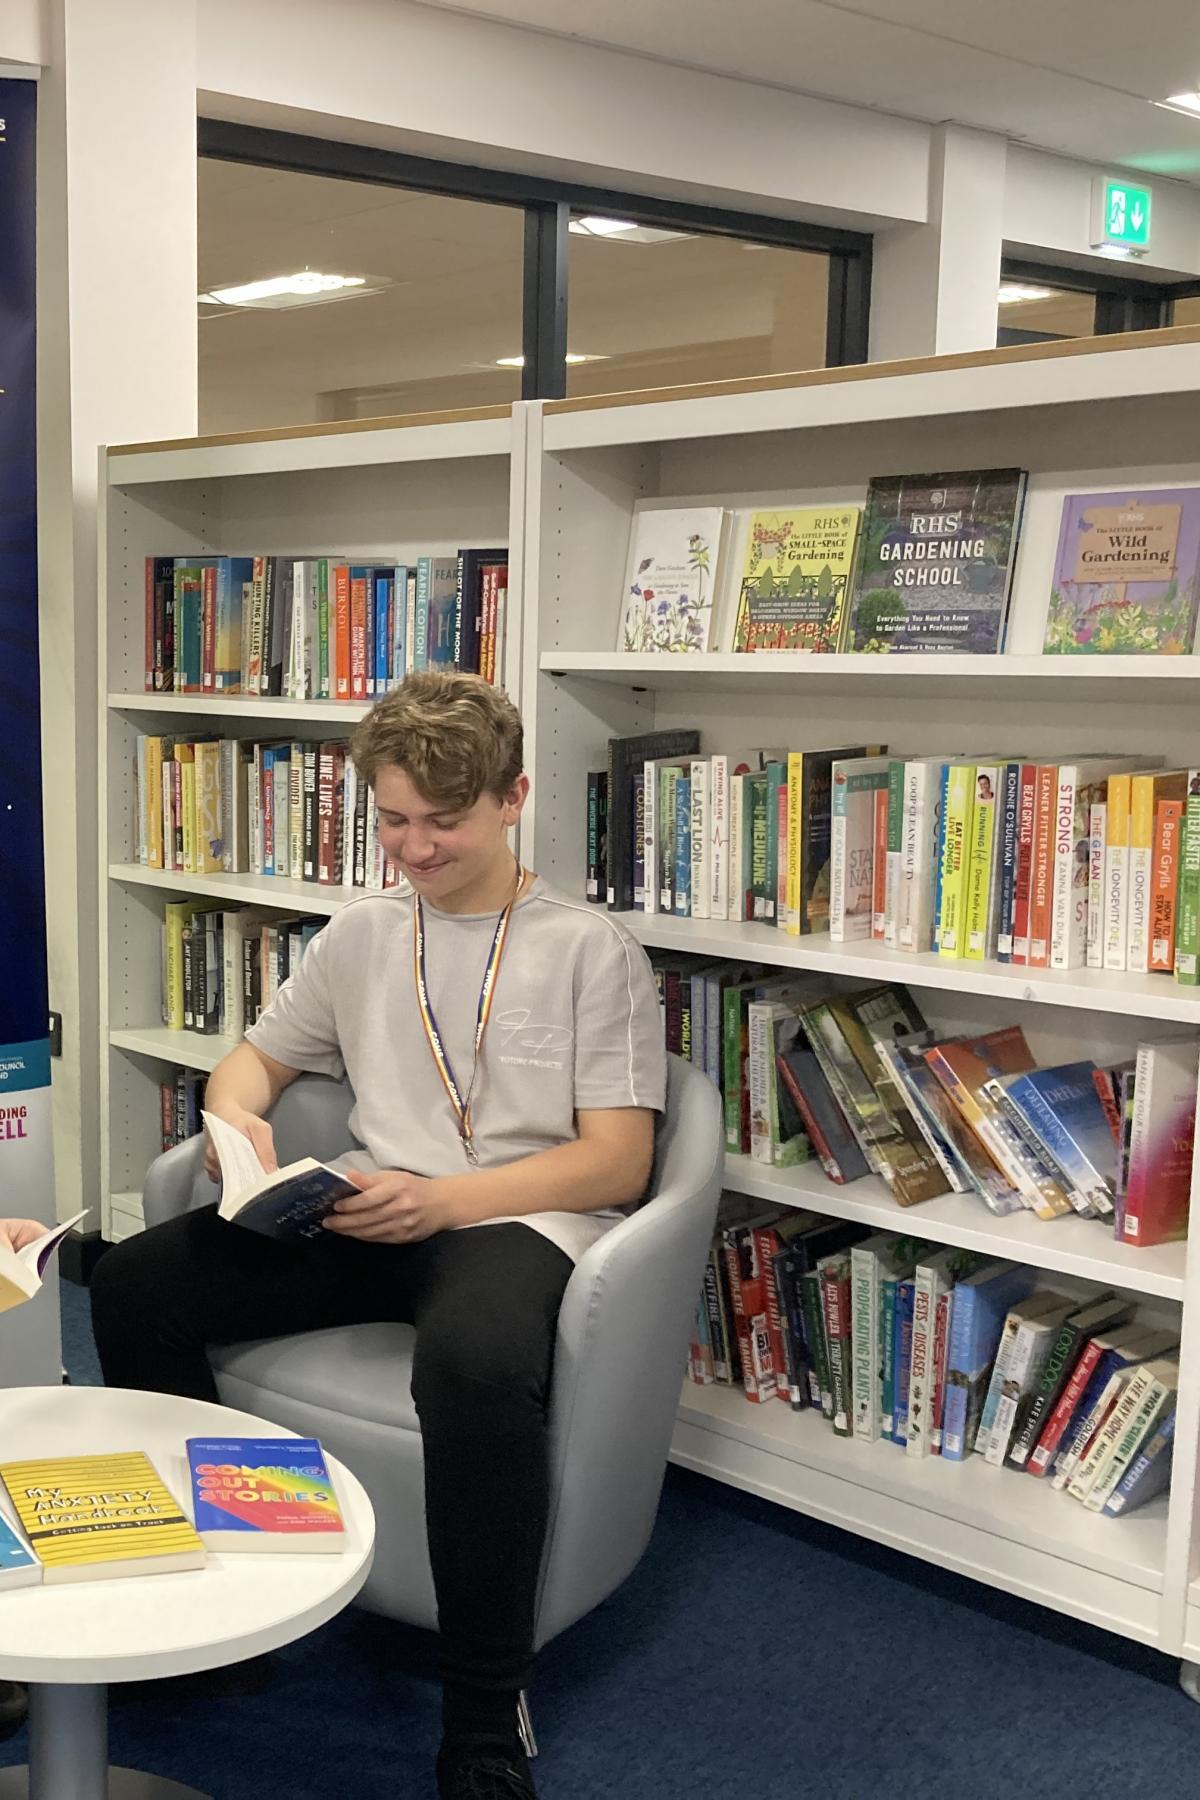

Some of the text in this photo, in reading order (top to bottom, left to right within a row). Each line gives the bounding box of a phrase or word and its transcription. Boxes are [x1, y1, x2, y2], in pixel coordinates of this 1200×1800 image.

[814, 519, 839, 529] RHS
[911, 515, 959, 533] RHS
[1109, 536, 1147, 547] Wild
[788, 550, 844, 560] Gardening
[789, 540, 846, 548] SMALL-SPACE
[880, 540, 985, 560] GARDENING
[1082, 549, 1170, 563] Gardening
[894, 568, 961, 586] SCHOOL
[254, 581, 262, 618] HUNTING
[416, 562, 426, 654] FEARNE COTTON
[291, 770, 300, 804] DIVIDED
[304, 753, 315, 792] TOM BOWER
[319, 755, 333, 816] NINE LIVES
[790, 776, 798, 814] ANATOMY
[1020, 785, 1034, 843] BEAR GRYLLS
[636, 787, 644, 855] COASTLINES
[692, 790, 703, 863] LAST LION
[977, 806, 987, 847] RUNNING
[1003, 773, 1016, 866] RONNIE O'SULLIVAN
[1058, 785, 1073, 855] STRONG
[946, 838, 954, 874] LONGER
[953, 840, 961, 871] BETTER
[1036, 773, 1050, 906] LEANER FITTER STRONGER
[1091, 816, 1103, 880] THE G PLAN
[1157, 822, 1175, 889] Bear Grylls
[1056, 861, 1068, 918] ZANNA VAN
[1110, 868, 1121, 925] LONGEVITY
[1134, 870, 1145, 927] LONGEVITY
[1153, 894, 1164, 940] STAY ALIVE
[1163, 901, 1172, 936] HOW TO
[705, 1267, 720, 1322] SPITFIRE
[728, 1255, 744, 1315] COMPLETE
[856, 1278, 872, 1401] PROPAGATING PLANTS
[912, 1291, 929, 1378] PESTS DISEASES
[1042, 1327, 1075, 1390] LOST DOG
[1029, 1396, 1044, 1422] KATE
[1105, 1377, 1148, 1441] THE WAY HOME
[1071, 1418, 1096, 1456] GOLDFISH
[196, 1464, 324, 1477] COMING
[197, 1477, 260, 1488] OUT
[25, 1487, 61, 1498] My
[34, 1490, 152, 1511] ANXIETY
[199, 1490, 328, 1502] STORIES
[39, 1504, 162, 1525] Handbook
